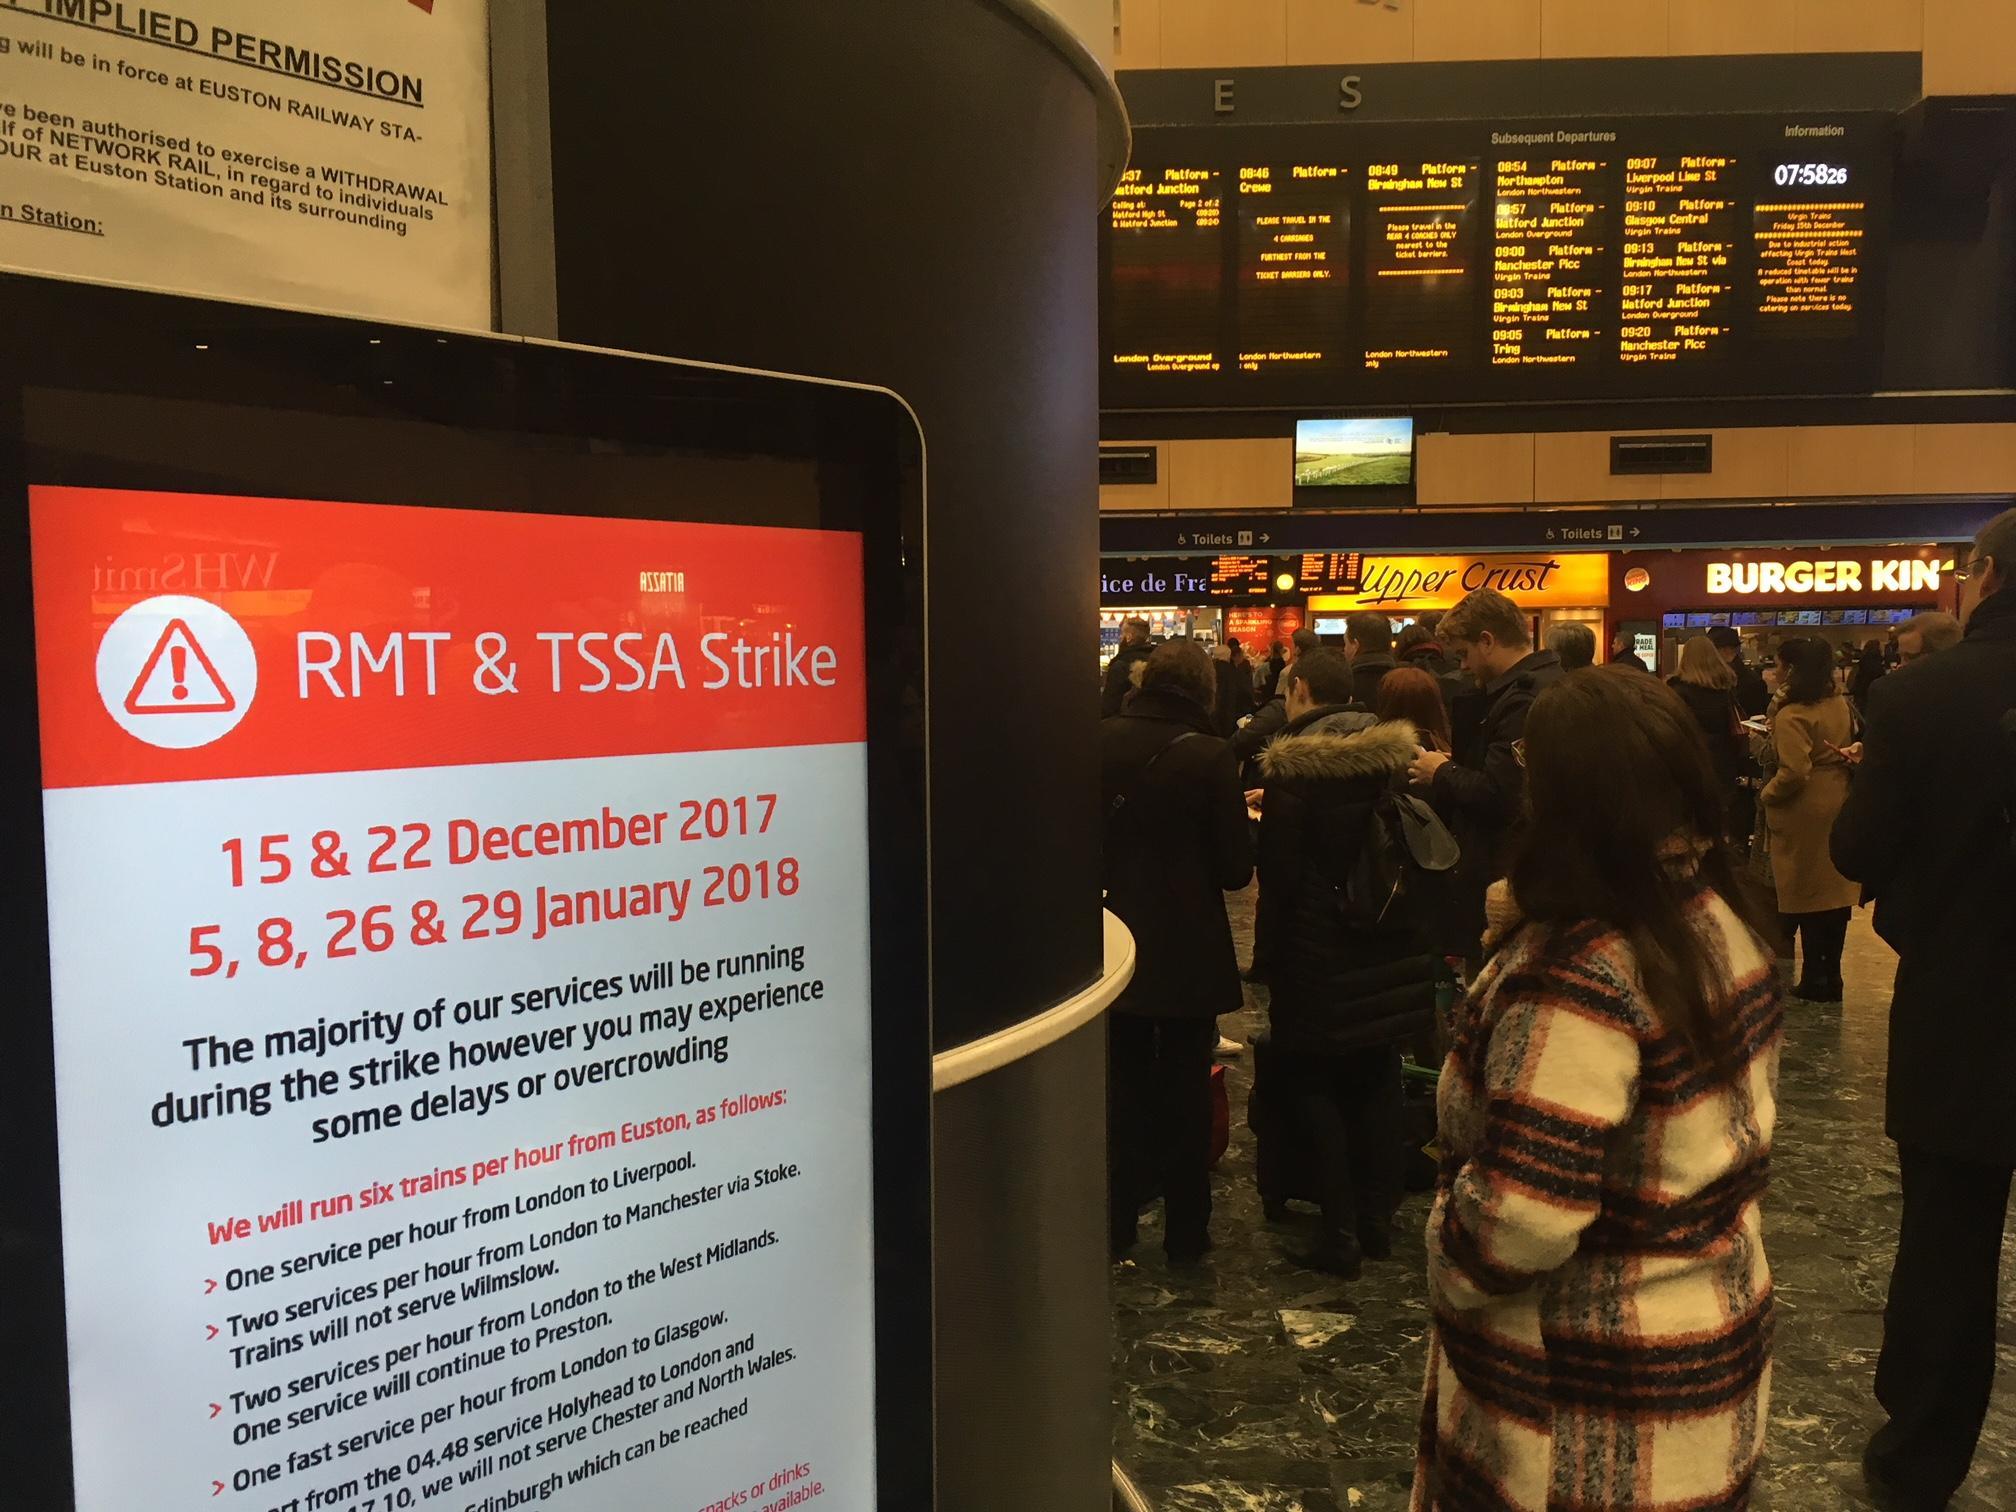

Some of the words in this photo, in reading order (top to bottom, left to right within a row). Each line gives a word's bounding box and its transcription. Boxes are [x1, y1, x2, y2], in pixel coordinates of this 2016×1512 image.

[212, 26, 422, 102] PERMISSION
[17, 40, 52, 60] will
[61, 47, 85, 67] be
[93, 54, 110, 72] in
[117, 60, 168, 85] force
[175, 77, 193, 92] at
[200, 79, 281, 112] EUSTON
[288, 99, 374, 132] RAILWAY
[381, 121, 422, 143] STA-
[1785, 125, 1844, 136] Information
[1491, 132, 1553, 145] Subsequent
[1557, 131, 1616, 144] Departures
[24, 104, 74, 129] been
[82, 120, 190, 153] authorised
[196, 141, 215, 157] to
[221, 149, 300, 175] exercise
[306, 167, 315, 179] a
[321, 166, 448, 206] WITHDRAWAL
[1369, 165, 1398, 176] 08:49
[1422, 164, 1466, 174] Platform
[1498, 161, 1527, 172] 08:54
[1627, 158, 1656, 169] 09:07
[23, 127, 43, 142] of
[51, 129, 161, 166] NETWORK
[169, 154, 220, 180] RAIL,
[228, 165, 244, 183] in
[251, 174, 310, 200] regard
[316, 185, 333, 200] to
[340, 188, 433, 220] individuals
[1240, 168, 1269, 179] 08:46
[1293, 166, 1337, 177] Platform
[1627, 172, 1674, 184] Liverpool
[1679, 171, 1700, 181] Lime
[1705, 171, 1716, 180] St
[1368, 179, 1423, 191] Birmingham
[1427, 178, 1447, 188] New
[1451, 177, 1463, 188] St
[1498, 175, 1563, 186] Northampton
[1157, 183, 1199, 194] Junction
[1240, 182, 1271, 193] Crewe
[49, 153, 68, 167] at
[76, 154, 147, 182] Euston
[155, 170, 223, 197] Station
[230, 189, 264, 205] and
[271, 193, 291, 211] its
[299, 202, 406, 237] surrounding
[1626, 201, 1655, 211] 09:10
[21, 204, 103, 234] Station:
[1495, 216, 1537, 229] Watford
[1541, 216, 1584, 227] Junction
[1625, 215, 1665, 226] Glasgow
[1669, 213, 1708, 224] Central
[1495, 246, 1525, 257] 09:00
[1624, 243, 1653, 254] 09:13
[1495, 259, 1554, 271] Manchester
[1559, 259, 1580, 269] Picc
[1624, 257, 1672, 268] Birmingham
[1676, 256, 1693, 266] New
[1697, 255, 1708, 265] St
[1712, 255, 1726, 265] via
[1494, 288, 1523, 299] 09:03
[1623, 285, 1652, 296] 09:17
[1494, 301, 1548, 313] Birmingham
[1553, 301, 1572, 311] New
[1576, 300, 1587, 310] St
[1622, 298, 1663, 309] Watford
[1667, 297, 1710, 308] Junction
[1493, 330, 1522, 340] 09:05
[1622, 327, 1650, 337] 09:20
[1494, 344, 1520, 355] Tring
[1621, 340, 1680, 351] Manchester
[1685, 339, 1705, 349] Picc
[1192, 534, 1233, 545] Toilets
[1561, 527, 1602, 540] Toilets
[1102, 574, 1133, 593] ice
[1141, 573, 1166, 592] de
[1175, 574, 1206, 592] Fra
[1361, 564, 1457, 604] Upper
[1461, 560, 1560, 591] Crust
[1707, 561, 1862, 594] BURGER
[298, 632, 450, 698] RMT
[474, 632, 518, 695] &
[537, 633, 685, 692] TSSA
[701, 632, 835, 689] Strike
[223, 835, 291, 887] 15
[311, 830, 351, 878] &
[368, 823, 431, 873] 22
[448, 807, 667, 864] December
[680, 794, 776, 840] 2017
[190, 925, 239, 978] 5,
[258, 918, 307, 968] 8,
[326, 905, 394, 958] 26
[411, 900, 447, 945] &
[463, 890, 521, 939] 29
[533, 879, 690, 939] January
[704, 858, 798, 906] 2018
[182, 1036, 254, 1071] The
[265, 1010, 404, 1058] majority
[414, 998, 445, 1032] of
[454, 995, 503, 1024] our
[511, 976, 623, 1015] services
[629, 961, 673, 993] will
[681, 960, 710, 985] be
[717, 946, 805, 980] running
[152, 1082, 271, 1127] during
[280, 1068, 339, 1103] the
[349, 1049, 440, 1090] strike
[449, 1025, 576, 1071] however
[583, 1015, 632, 1051] you
[640, 1004, 692, 1033] may
[699, 980, 823, 1022] experience
[312, 1104, 402, 1143] some
[411, 1081, 509, 1121] delays
[518, 1073, 546, 1098] or
[554, 1036, 728, 1091] overcrowding
[208, 1217, 251, 1245] We
[258, 1200, 302, 1232] will
[311, 1195, 352, 1220] run
[360, 1182, 394, 1208] six
[399, 1167, 466, 1197] trains
[473, 1156, 508, 1185] per
[515, 1143, 563, 1170] hour
[568, 1131, 615, 1156] from
[622, 1114, 690, 1143] Euston,
[696, 1106, 715, 1124] as
[720, 1090, 786, 1118] follows:
[233, 1464, 280, 1491] One
[287, 1443, 333, 1474] fast
[338, 1418, 414, 1457] service
[421, 1404, 455, 1433] per
[460, 1386, 506, 1415] hour
[511, 1370, 555, 1397] from
[561, 1345, 627, 1379] London
[632, 1337, 650, 1354] to
[655, 1311, 727, 1346] Glasgow.
